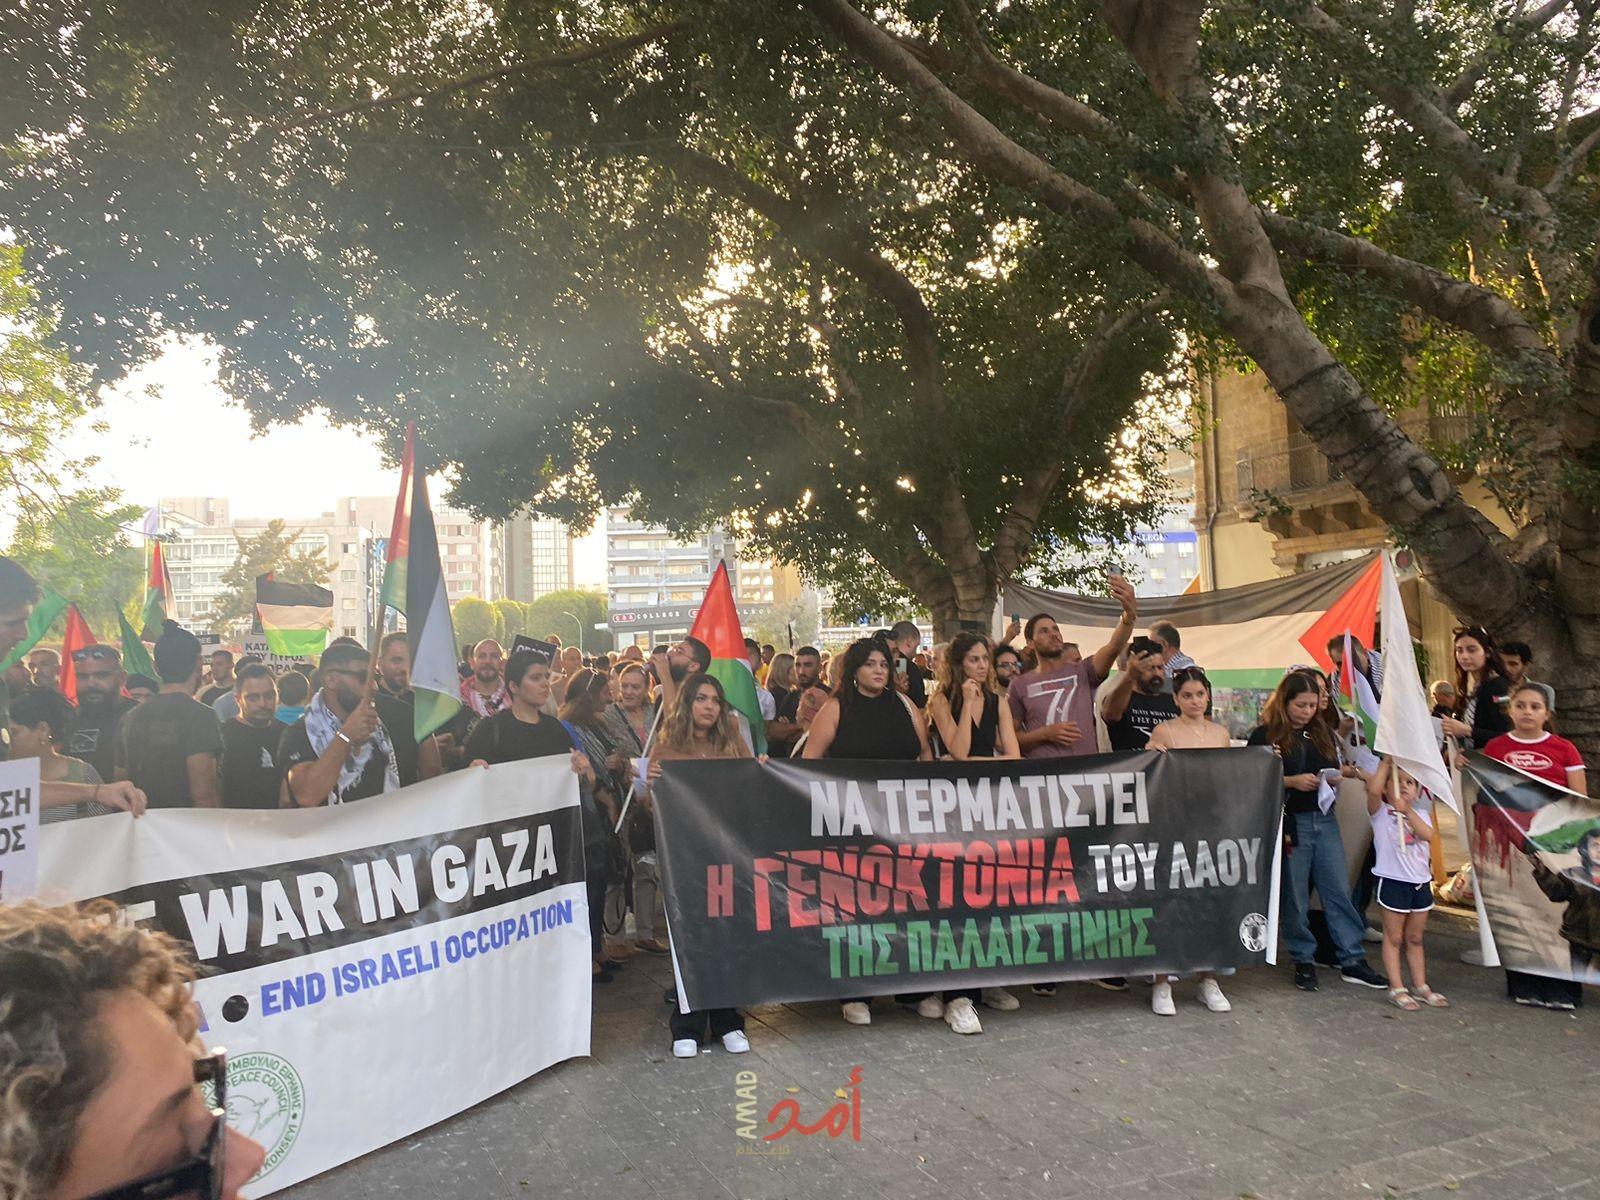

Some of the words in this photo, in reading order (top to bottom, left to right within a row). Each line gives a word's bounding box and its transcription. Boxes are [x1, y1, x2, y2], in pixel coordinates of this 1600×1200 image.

[808, 780, 874, 836] ΝΑ
[877, 771, 1150, 835] ΤΕΡΜΑΤΙΣΤΕΙ
[179, 871, 346, 960] WAR
[352, 855, 420, 925] IN
[430, 823, 559, 904] GAZA
[706, 864, 734, 918] Η
[753, 837, 1081, 932] ΓΕΝΟΚΤΟΝΙΑ
[1087, 842, 1160, 893] ΤΟΥ
[1169, 838, 1262, 889] ΛΑΟΥ
[260, 971, 326, 1018] END
[332, 940, 440, 997] ISRAELI
[444, 899, 573, 964] OCCUPATION
[822, 925, 899, 979] ΤΗΣ
[907, 907, 1157, 974] ΠΑΛΑΙΣΤΙΝΗΣ
[226, 1056, 281, 1073] ΥΜΒΟΥΛΙΟ
